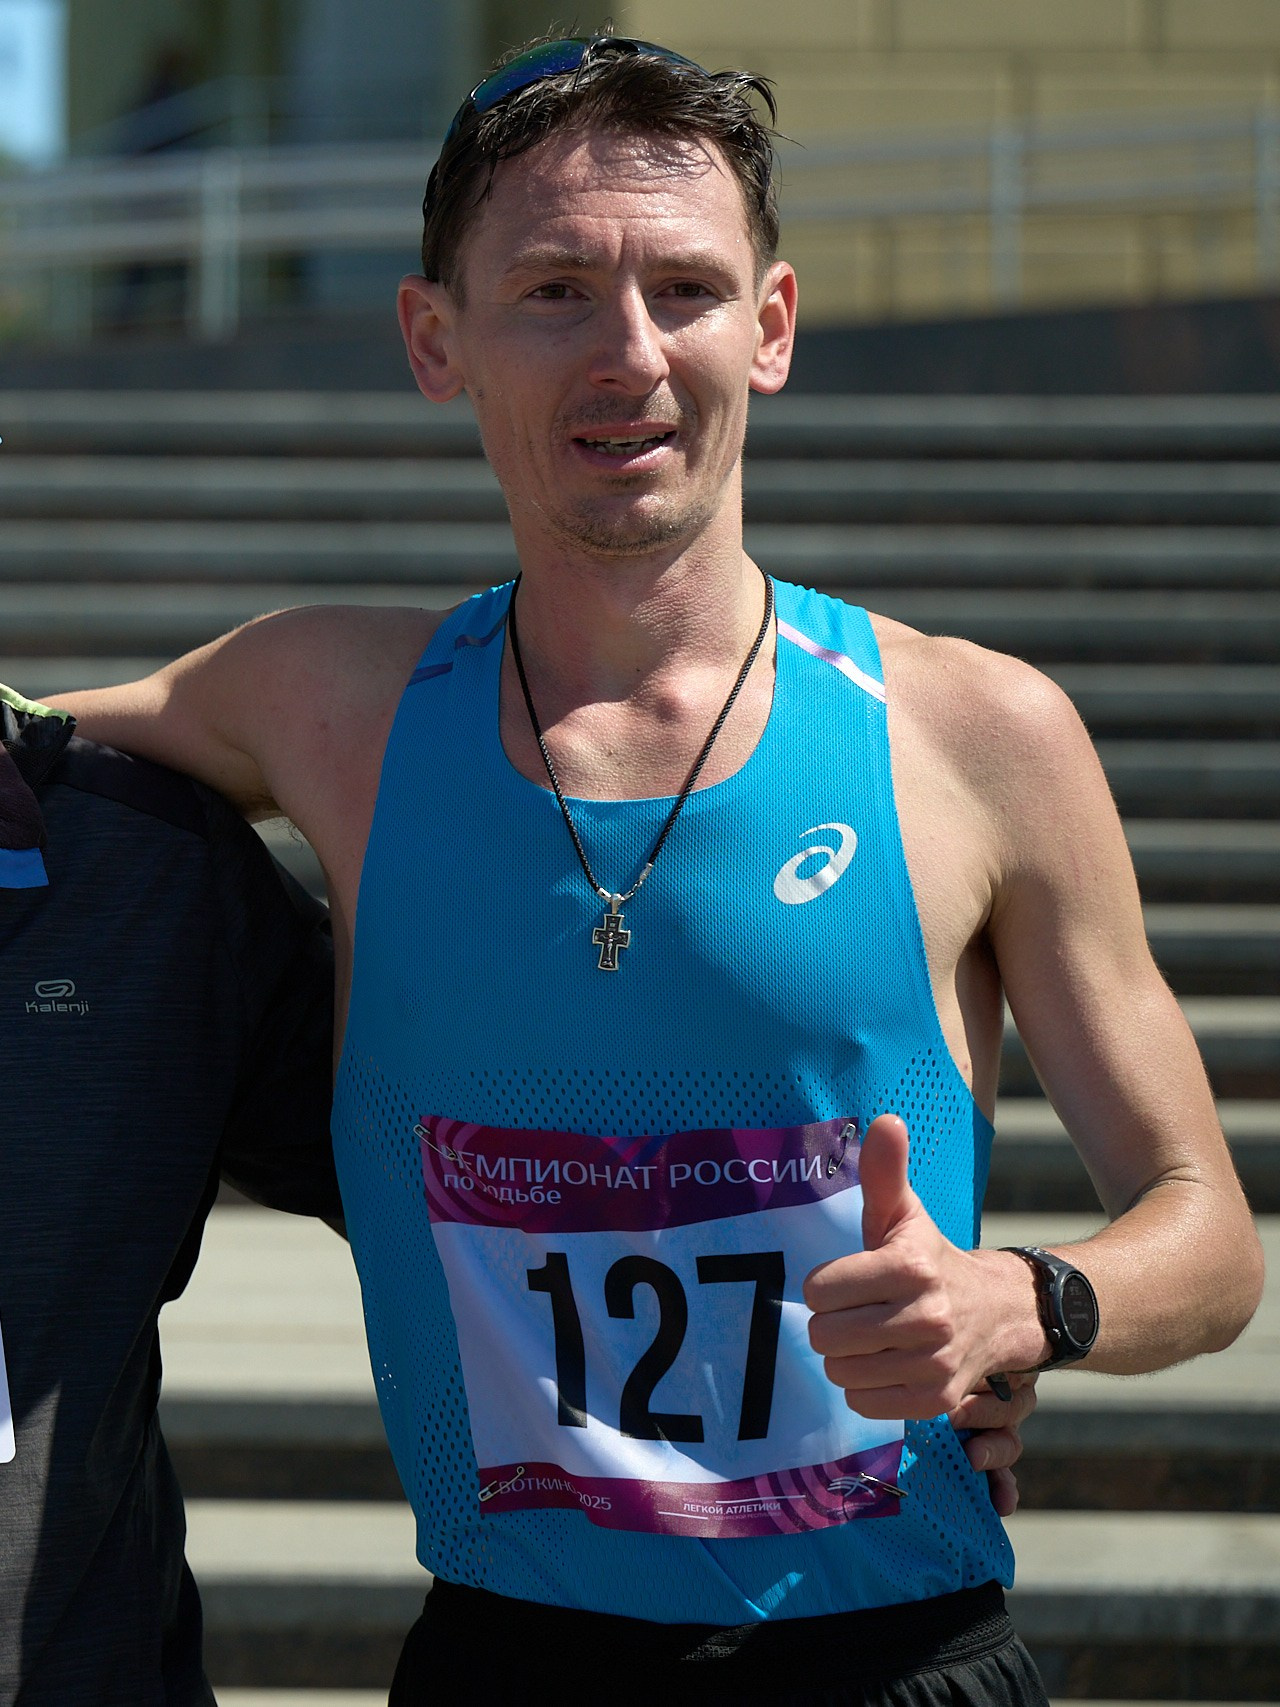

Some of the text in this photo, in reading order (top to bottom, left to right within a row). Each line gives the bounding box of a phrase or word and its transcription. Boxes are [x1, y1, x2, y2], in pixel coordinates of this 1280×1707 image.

[25, 1000, 89, 1016] Kalenji
[669, 1154, 823, 1188] РОССИИ
[443, 1174, 475, 1191] по
[526, 1251, 786, 1443] 127
[683, 1502, 781, 1515] ЛЕГКОЙ АТЛЕТИКИ
